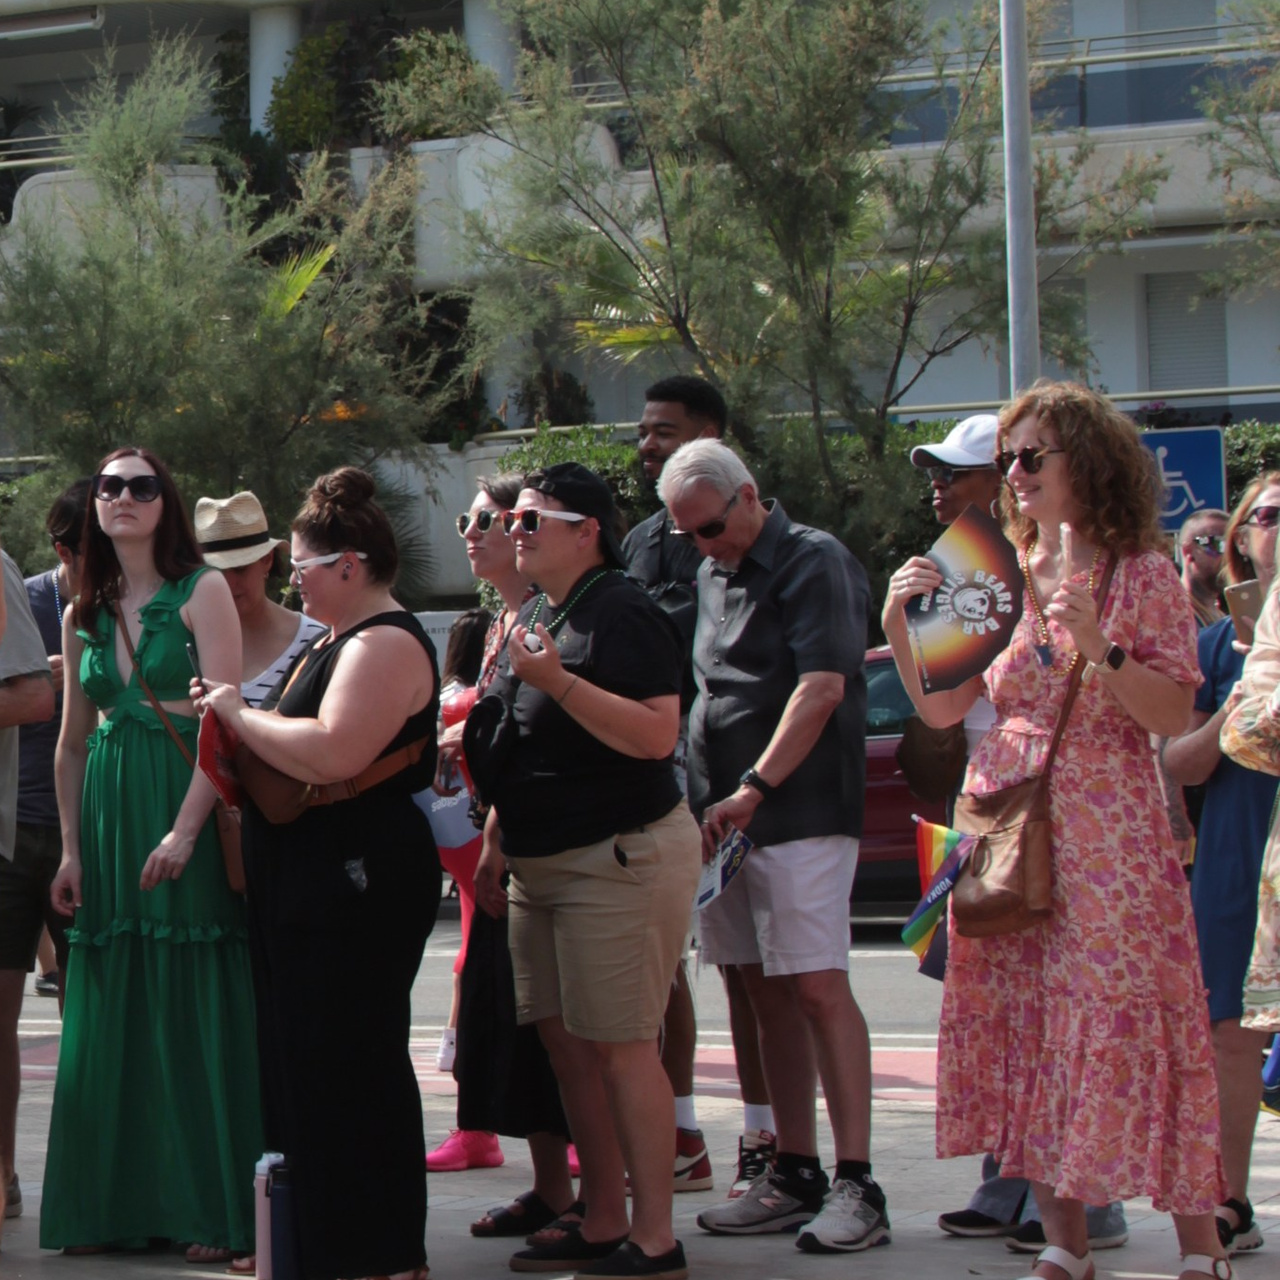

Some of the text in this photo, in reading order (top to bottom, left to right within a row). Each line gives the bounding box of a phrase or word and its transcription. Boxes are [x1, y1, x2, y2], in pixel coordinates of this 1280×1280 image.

[935, 570, 1013, 635] BEARS BAR SITGES
[927, 878, 952, 904] VODKA
